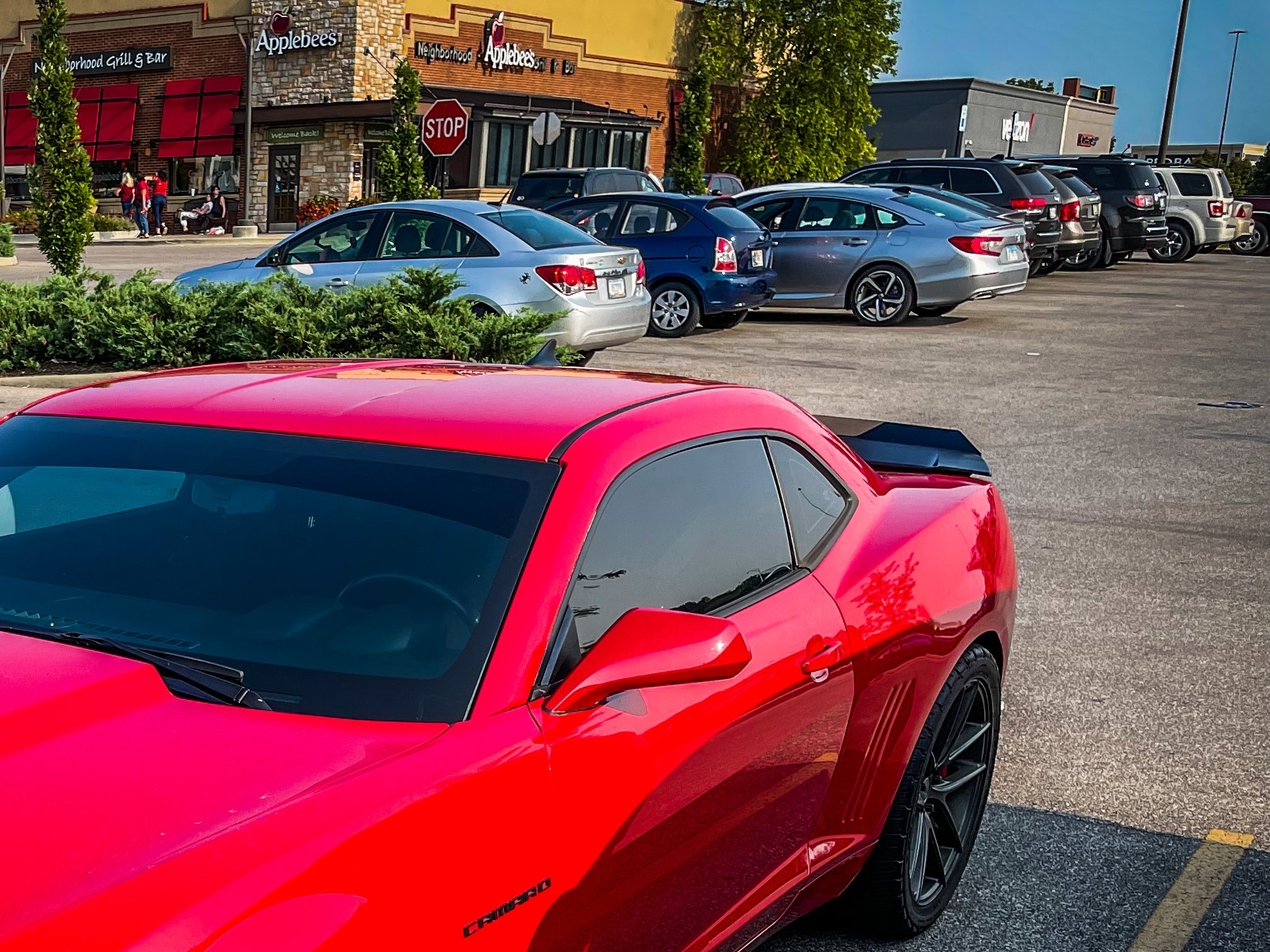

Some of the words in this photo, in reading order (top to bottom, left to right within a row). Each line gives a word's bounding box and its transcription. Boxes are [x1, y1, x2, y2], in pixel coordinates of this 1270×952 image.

[106, 52, 133, 69] Grill
[134, 52, 143, 68] &
[145, 52, 167, 64] Bar
[425, 117, 464, 139] STOP
[463, 877, 552, 938] CAMARO
